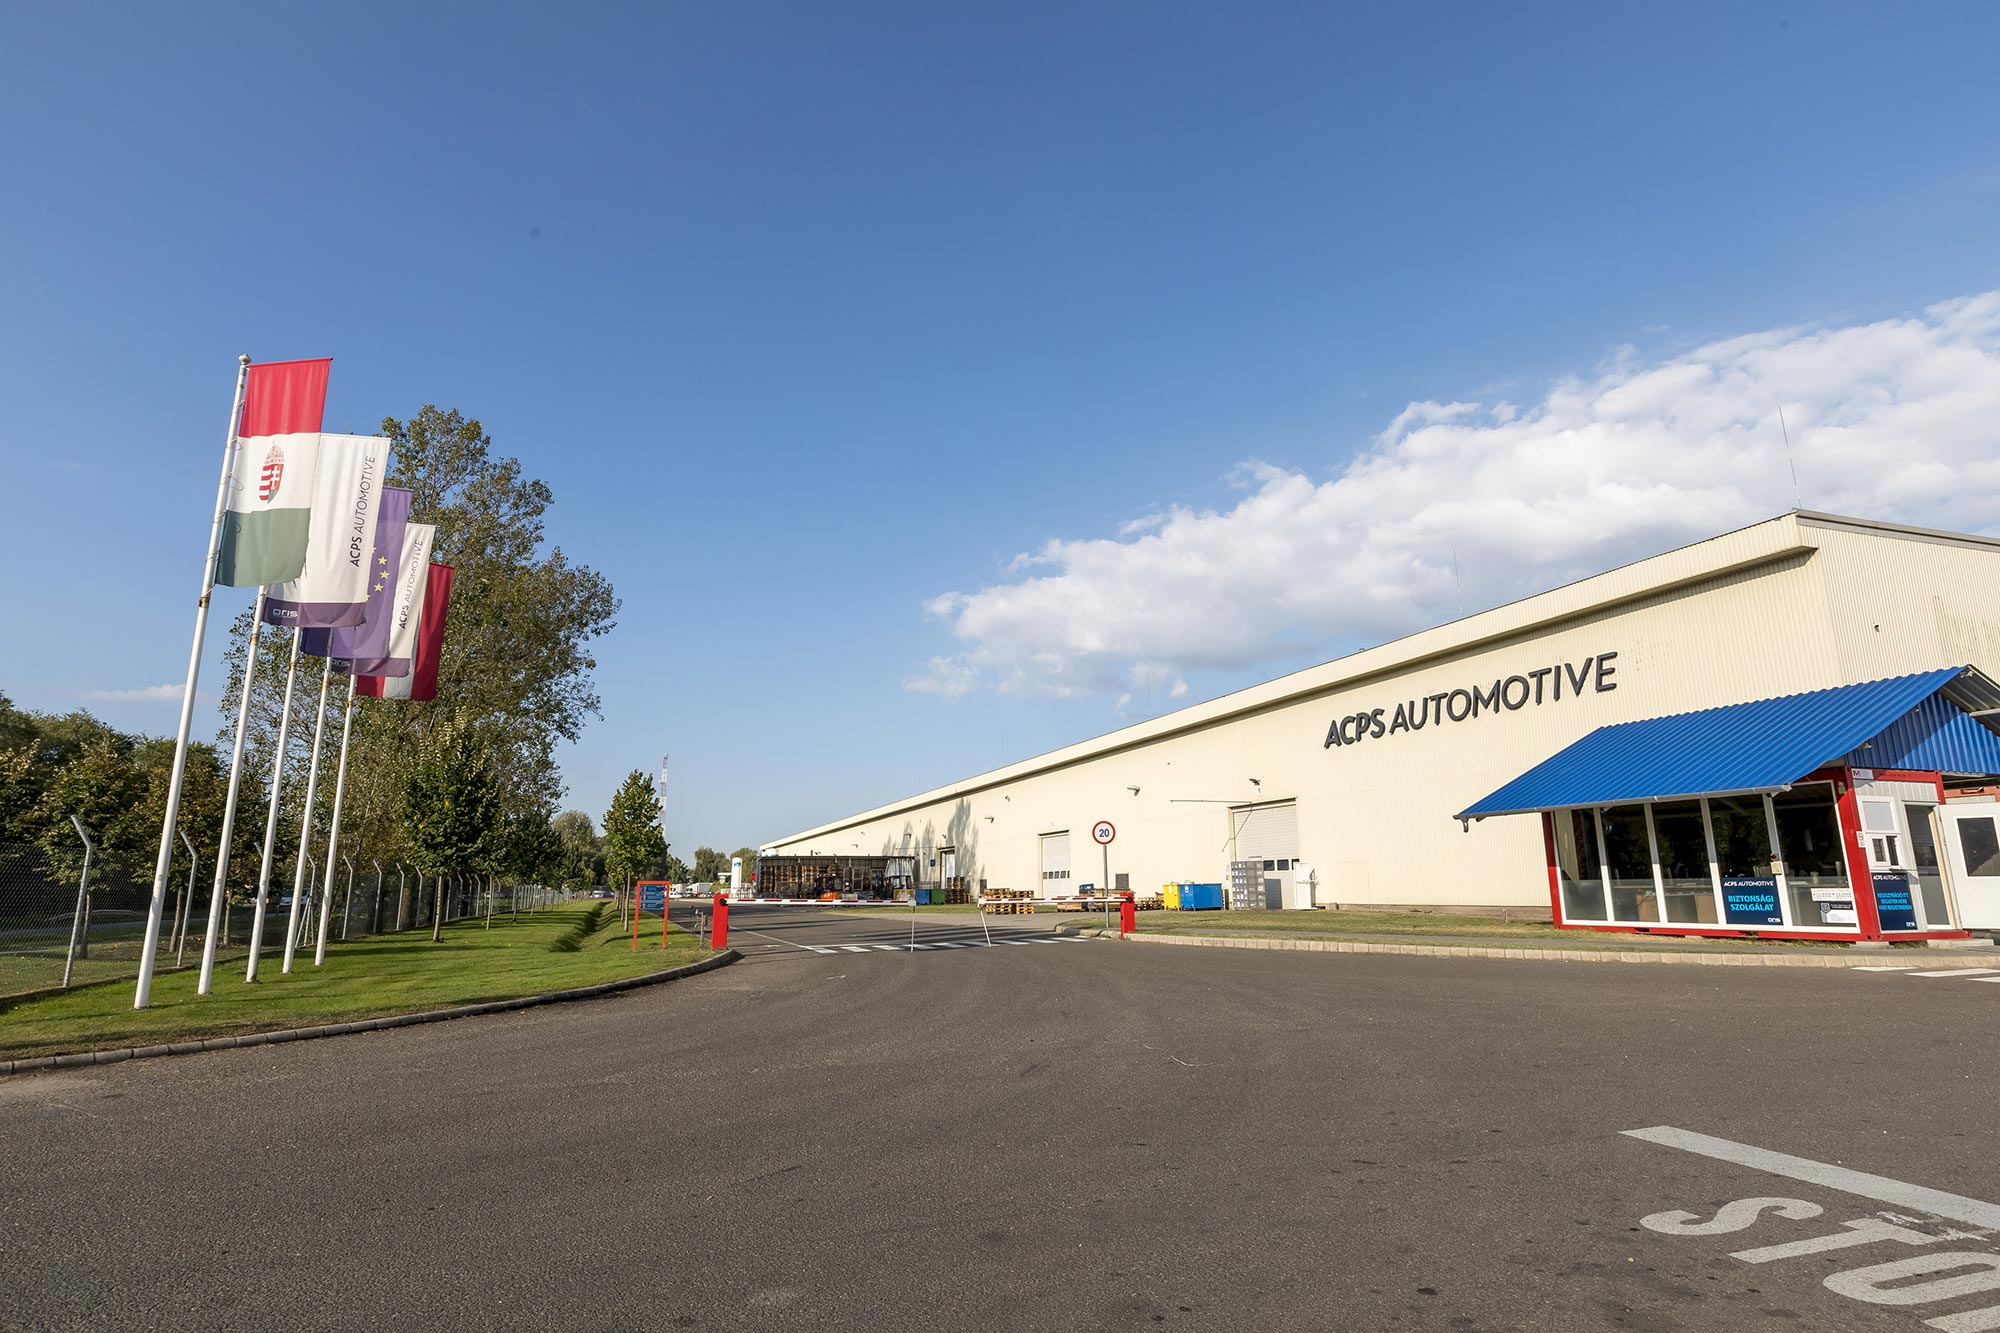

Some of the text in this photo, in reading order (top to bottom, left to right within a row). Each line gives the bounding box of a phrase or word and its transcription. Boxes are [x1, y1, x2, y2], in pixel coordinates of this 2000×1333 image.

[349, 455, 376, 567] ACPS AUTOMOTIVE
[399, 539, 424, 630] ACPS AUTOMOTIVE
[1324, 651, 1618, 750] ACPS AUTOMOTIVE
[1099, 828, 1110, 838] 20
[1727, 894, 1775, 903] BIZTONSÁGI
[1730, 903, 1775, 911] SZOLGÁLAT
[1640, 1197, 2000, 1333] STO
